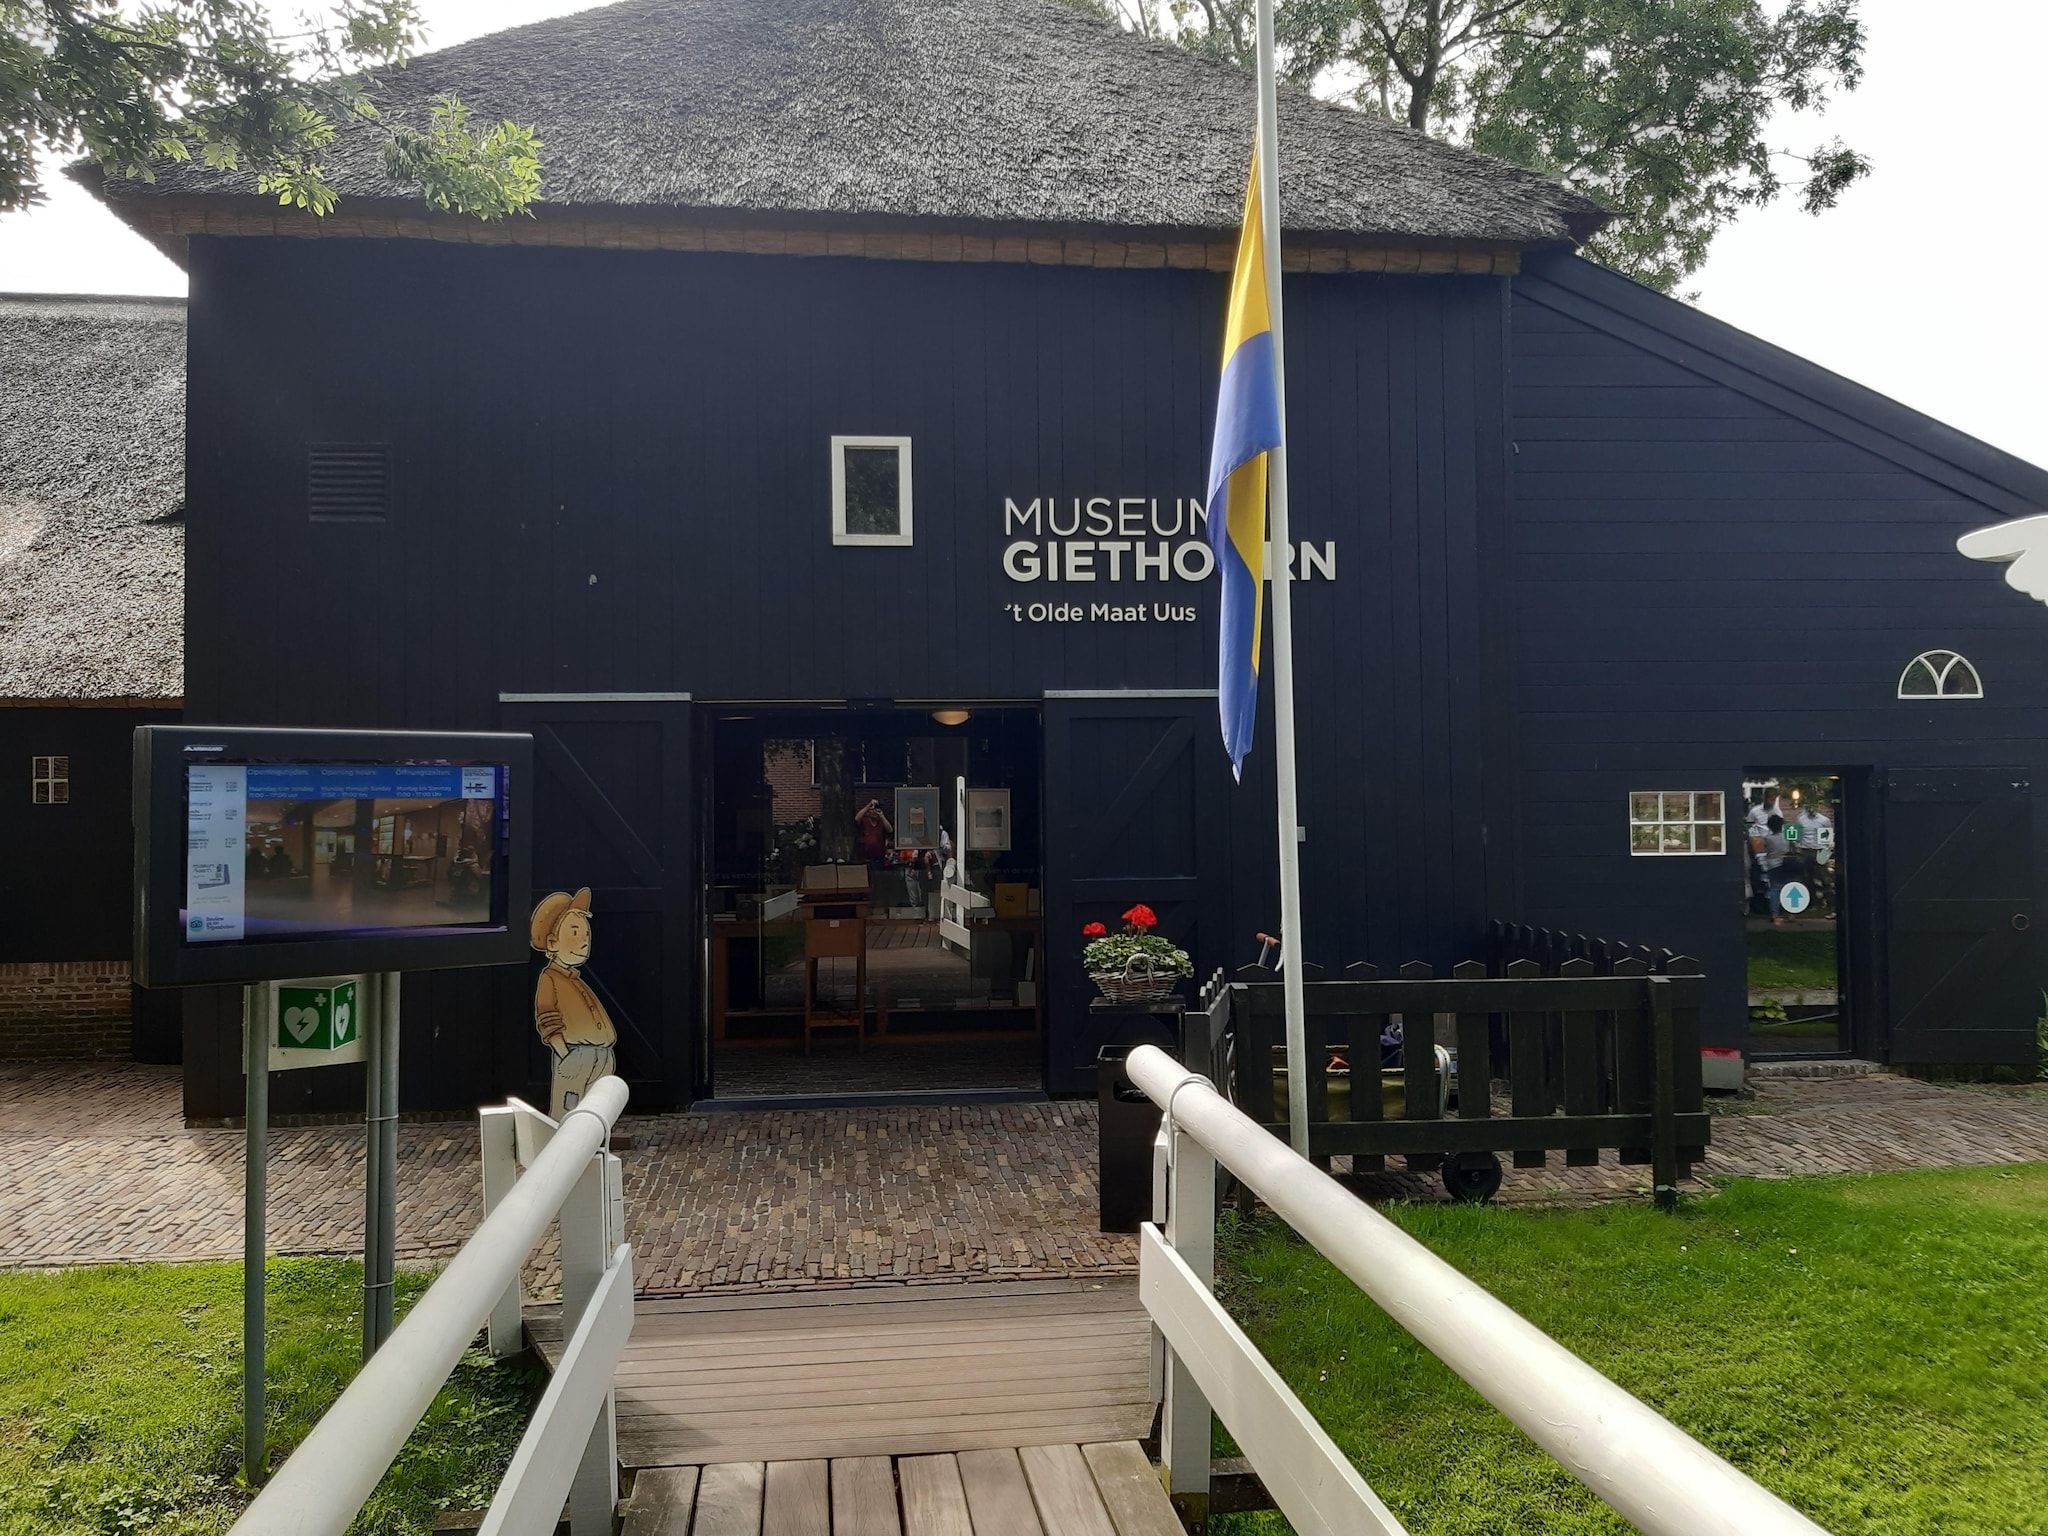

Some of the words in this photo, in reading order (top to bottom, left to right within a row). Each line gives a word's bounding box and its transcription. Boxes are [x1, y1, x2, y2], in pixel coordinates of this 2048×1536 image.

[1002, 540, 1336, 582] GIETHORN
[1028, 602, 1084, 623] Olde
[1090, 603, 1147, 622] Maat
[1153, 603, 1197, 623] Uus
